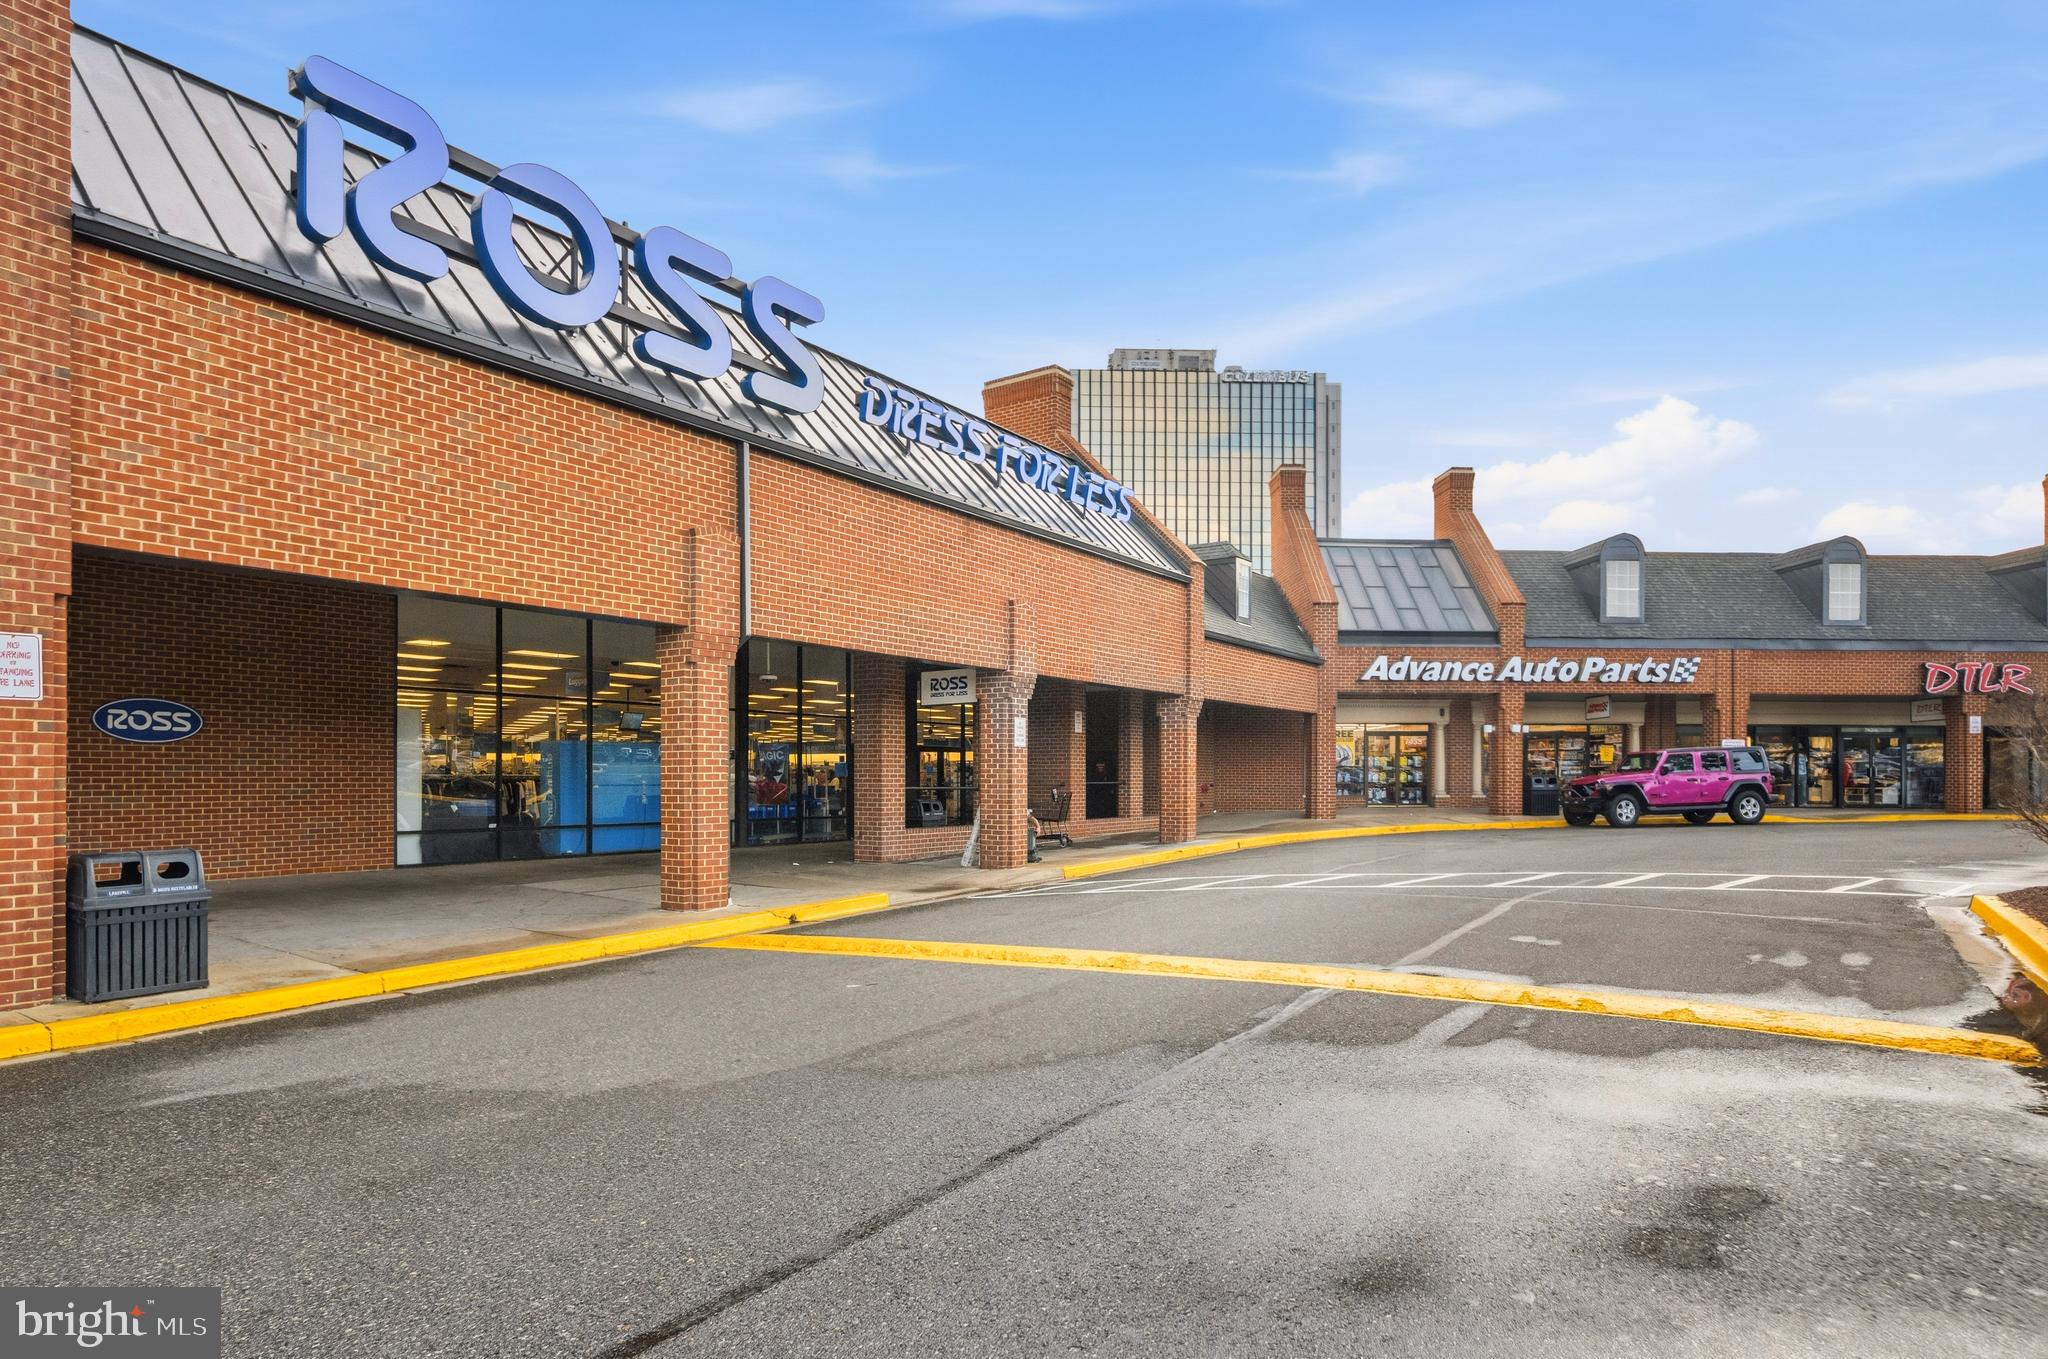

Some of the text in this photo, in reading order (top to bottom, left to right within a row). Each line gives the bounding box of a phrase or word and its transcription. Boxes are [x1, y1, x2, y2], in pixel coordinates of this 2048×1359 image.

[297, 55, 826, 414] ROSS
[859, 376, 1135, 522] DRESS FOR LESS
[7, 641, 20, 649] NO
[0, 651, 31, 659] ARKING
[0, 667, 33, 676] TANDING
[1361, 655, 1494, 682] Advance
[13, 679, 35, 687] LANE
[930, 676, 968, 691] ROSS
[1925, 662, 2034, 695] DTLR
[107, 709, 192, 732] ROSS
[759, 750, 784, 761] AGIC
